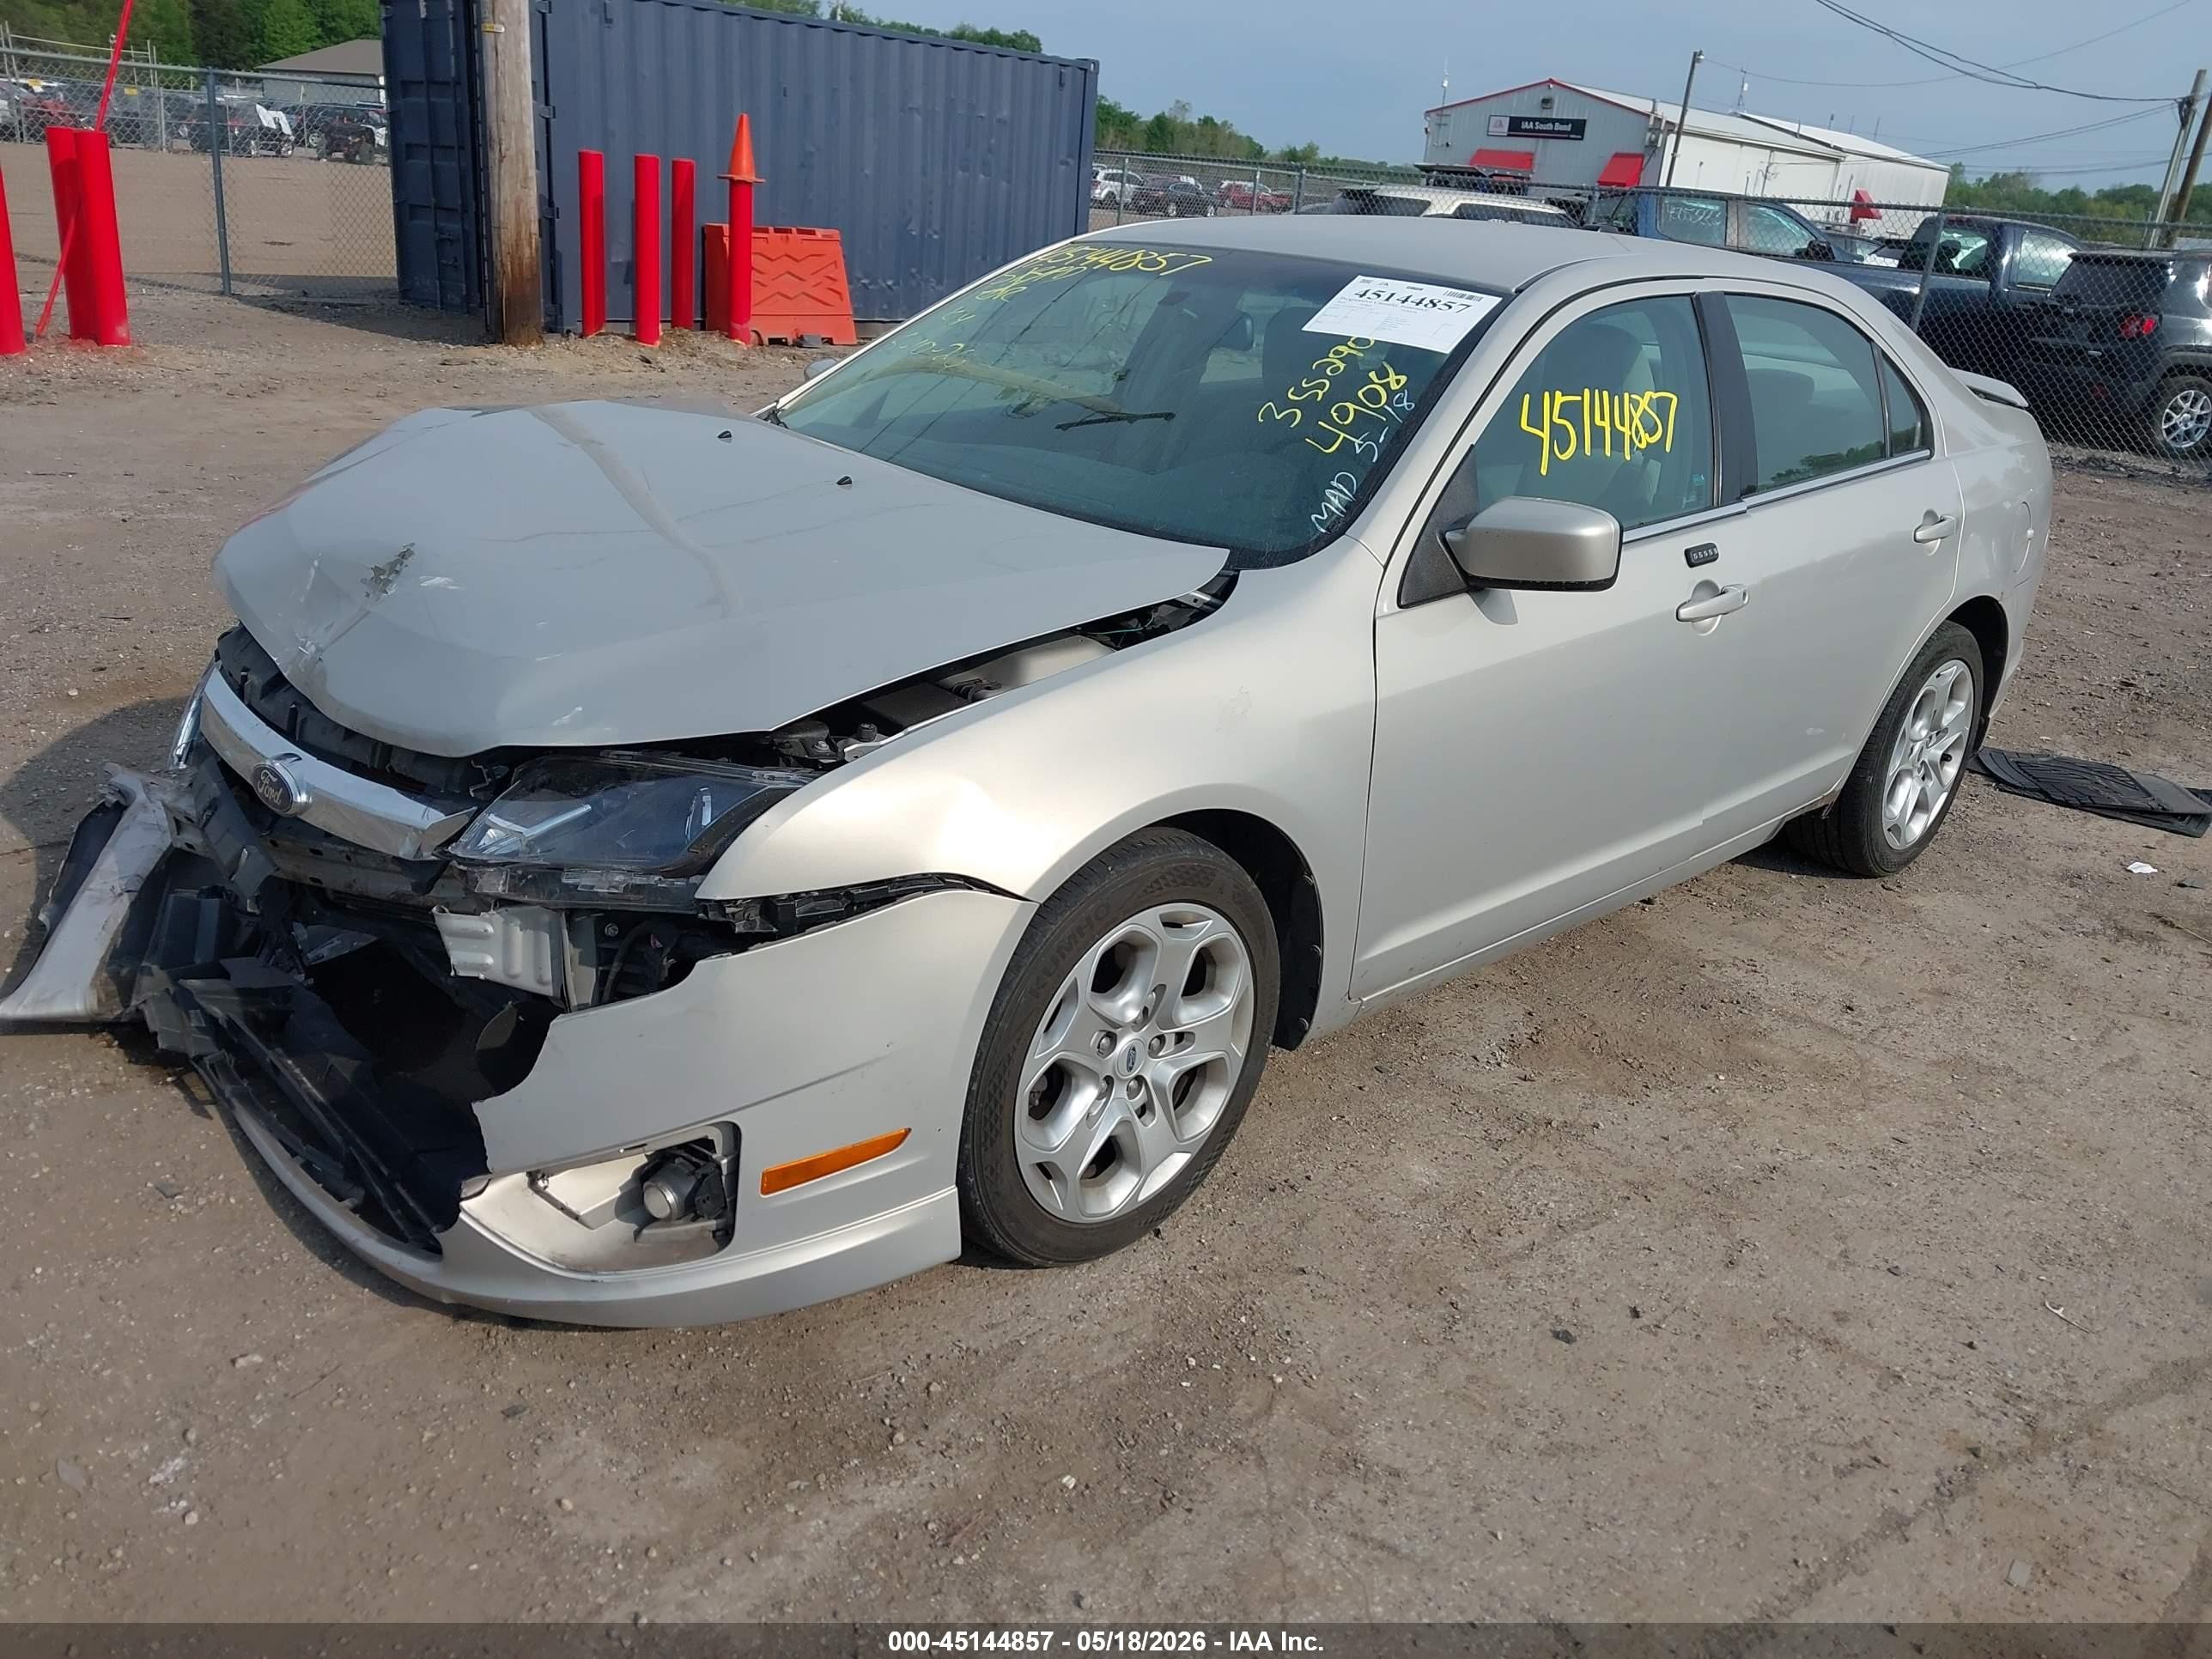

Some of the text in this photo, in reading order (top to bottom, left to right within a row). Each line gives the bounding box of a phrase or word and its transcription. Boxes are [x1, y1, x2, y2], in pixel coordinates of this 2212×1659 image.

[1521, 121, 1533, 130] IAA
[1353, 288, 1474, 314] 45144857
[1304, 361, 1408, 453] 4908
[1520, 388, 1679, 477] 45144857
[258, 769, 283, 805] Ford
